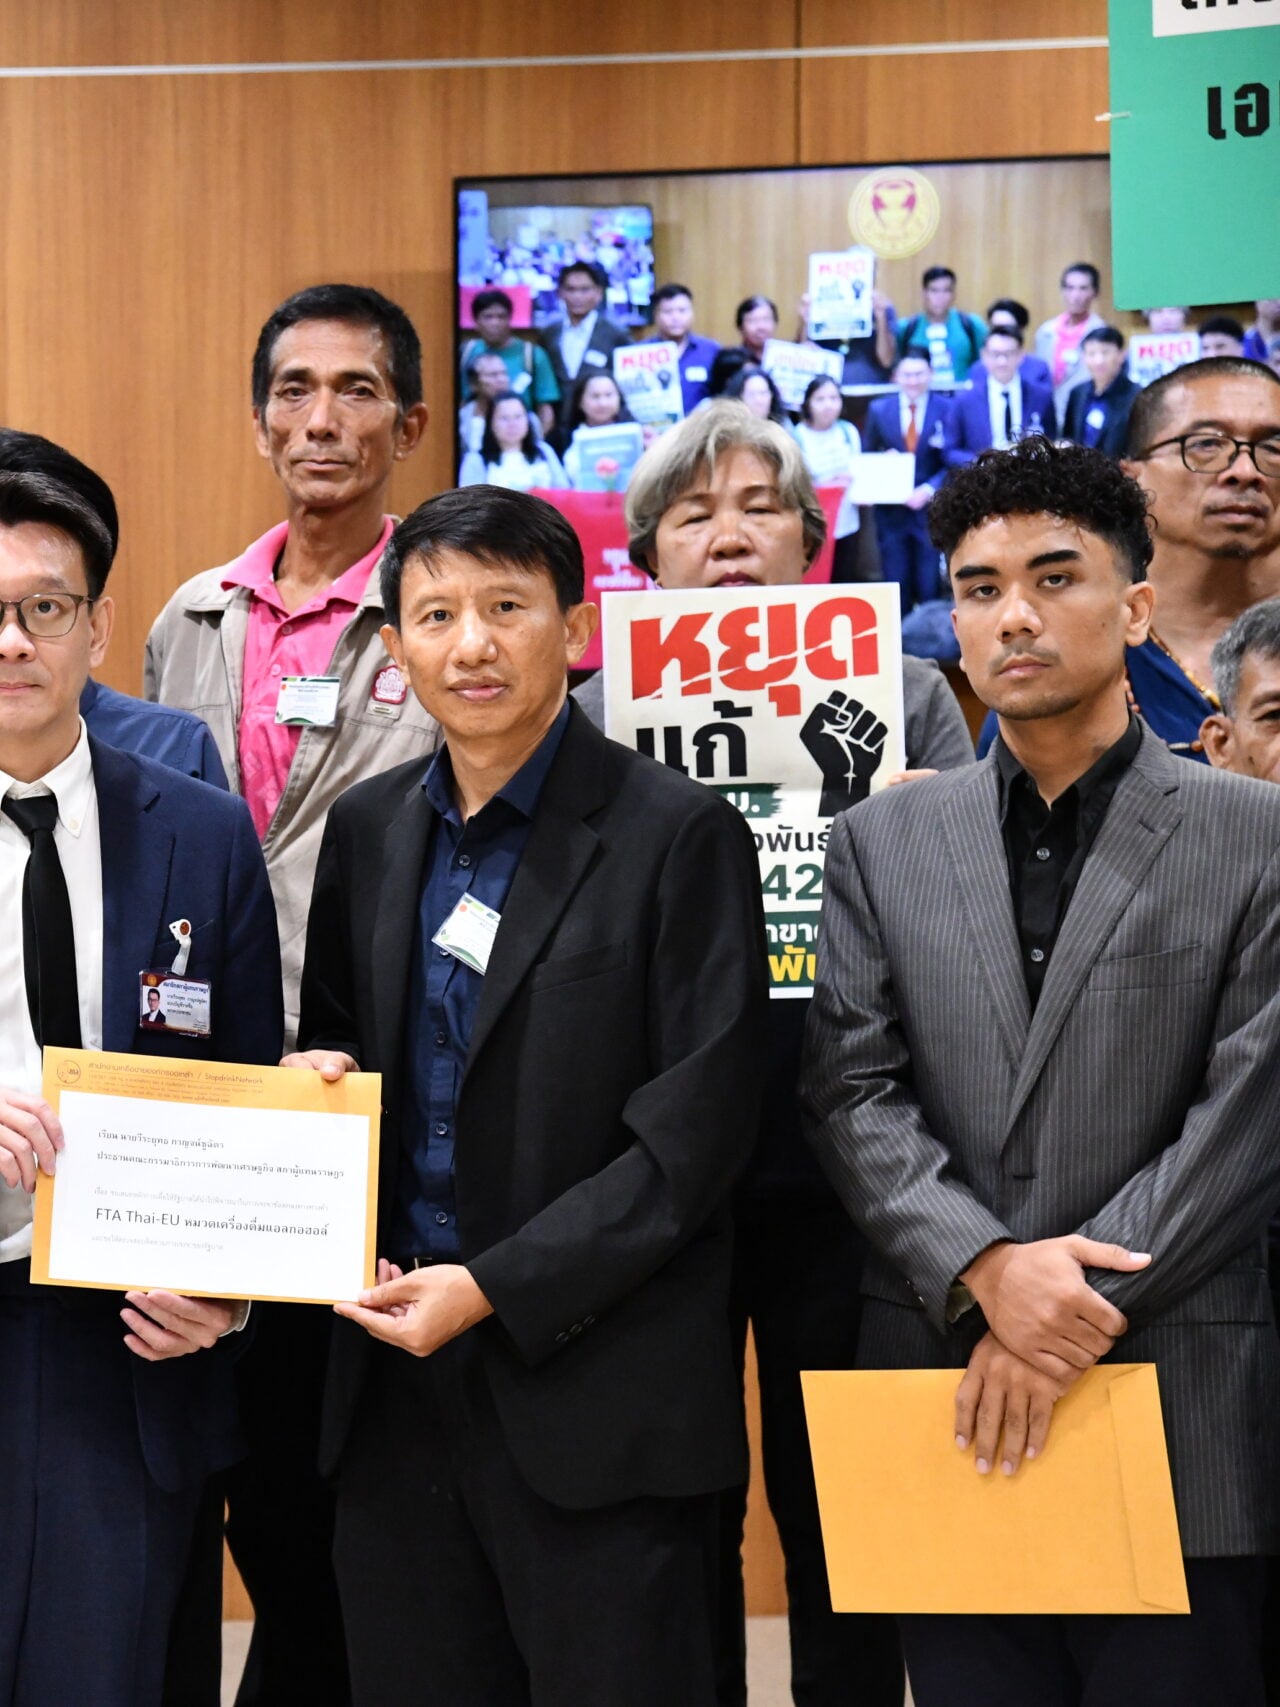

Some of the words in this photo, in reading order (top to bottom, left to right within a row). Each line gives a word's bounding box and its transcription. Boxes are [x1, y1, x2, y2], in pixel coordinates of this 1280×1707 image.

[1207, 80, 1280, 140] เอ
[630, 596, 879, 717] หยุด
[636, 699, 752, 778] แก้
[762, 863, 823, 901] 42
[98, 1129, 118, 1140] เรียน
[96, 1207, 122, 1223] FTA
[126, 1209, 181, 1227] Thai-EU
